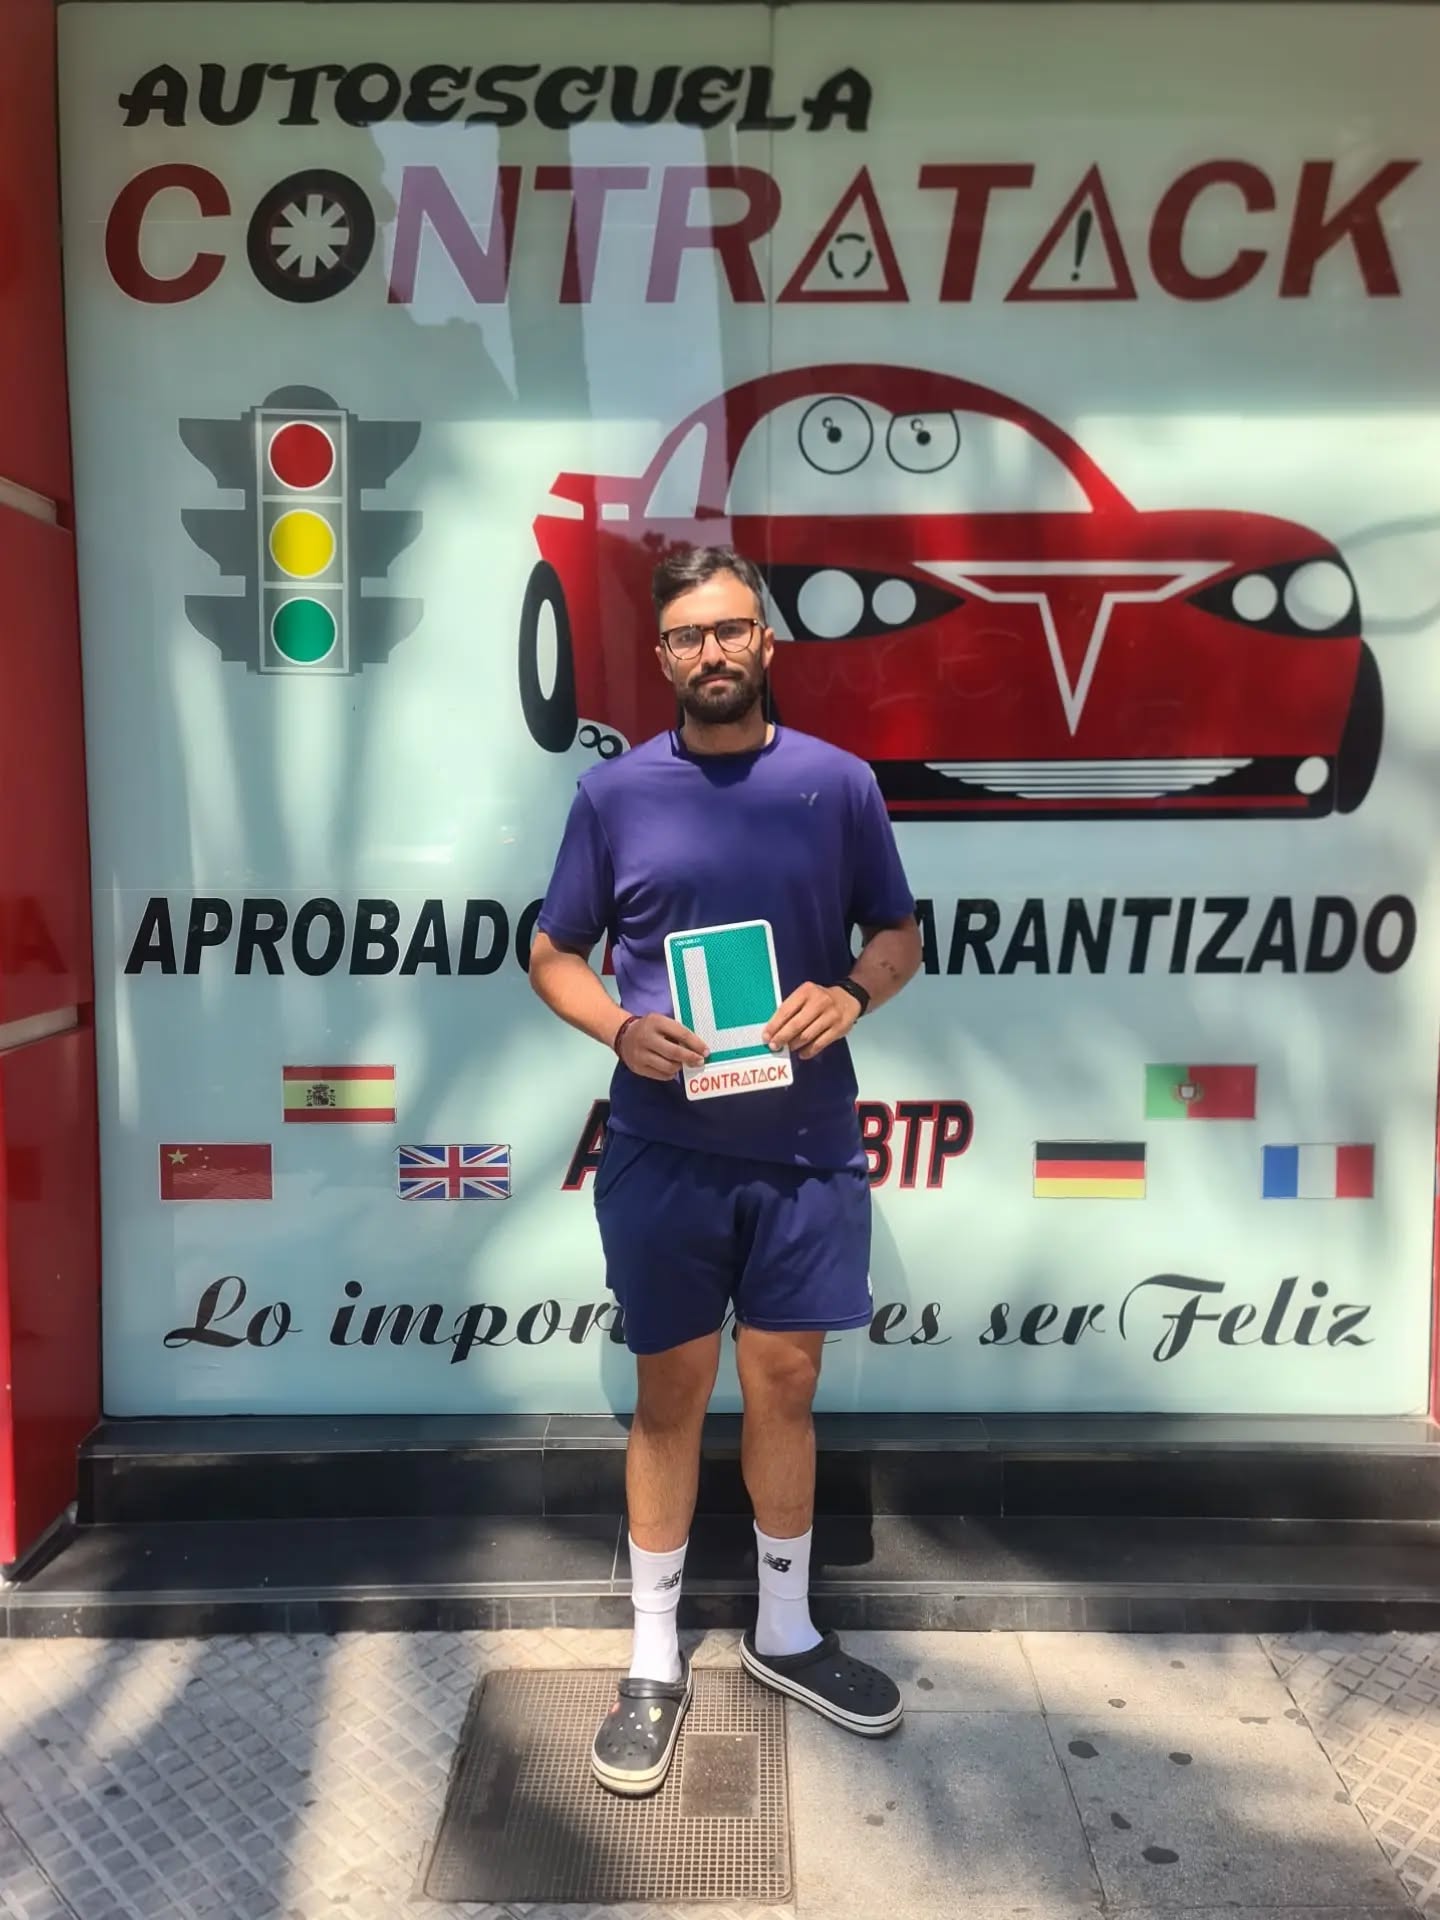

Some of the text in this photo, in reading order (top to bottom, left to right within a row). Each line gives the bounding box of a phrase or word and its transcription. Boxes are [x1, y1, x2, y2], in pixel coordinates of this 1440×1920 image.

[118, 62, 873, 132] AUTOESCUELA
[104, 158, 1422, 304] CONTRATACK
[912, 895, 1417, 975] ARANTIZADO
[682, 945, 767, 1053] L
[689, 1064, 789, 1094] CONTRATACK
[855, 1099, 974, 1189] BTP
[163, 1275, 303, 1349] Lo
[868, 1302, 952, 1346] es
[979, 1302, 1105, 1346] ser
[1118, 1273, 1375, 1363] Feliz
